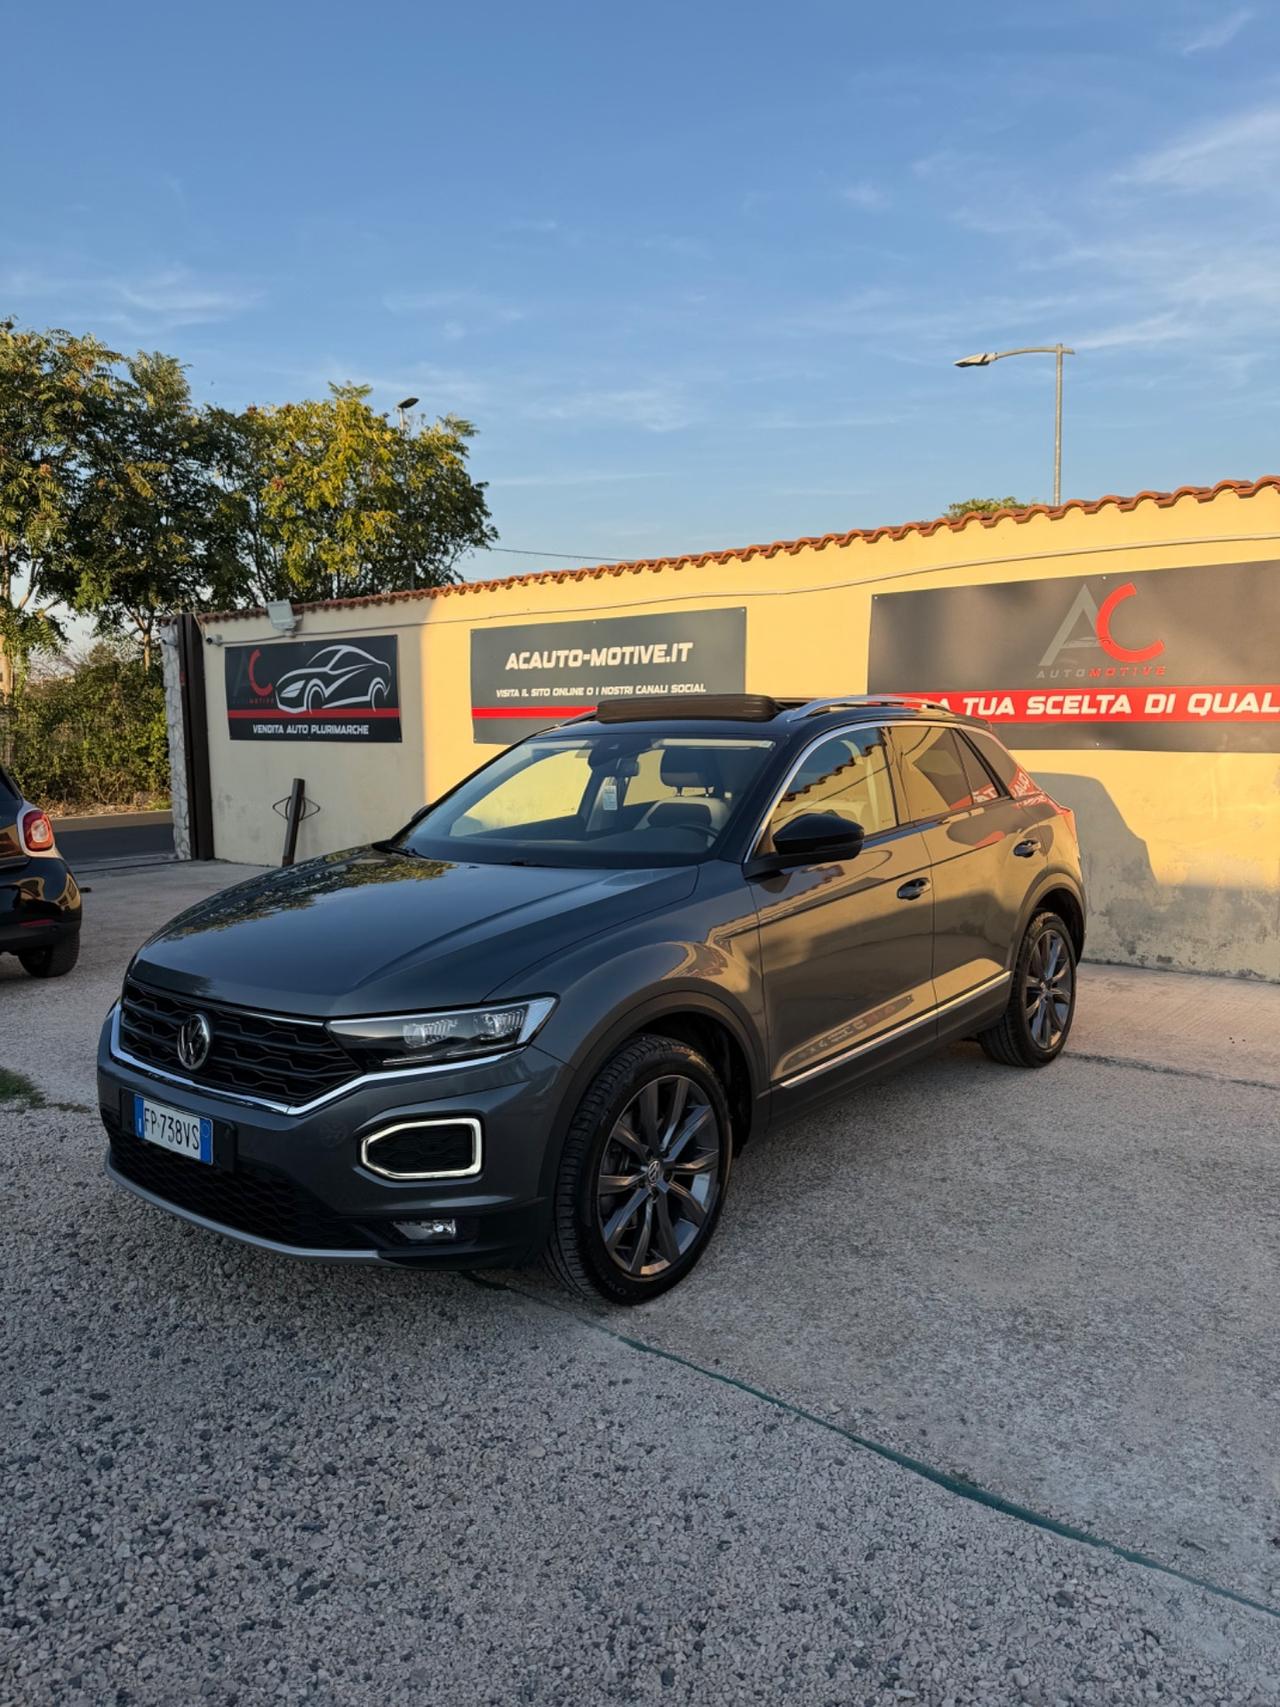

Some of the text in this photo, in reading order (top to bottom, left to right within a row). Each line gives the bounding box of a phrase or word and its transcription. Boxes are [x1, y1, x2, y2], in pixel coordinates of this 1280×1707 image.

[1038, 582, 1165, 664] AC
[505, 642, 693, 670] ACAUTO-MOTIVE.IT
[1036, 666, 1166, 679] AUTOMOTIVE
[496, 683, 707, 698] VISITA IL SITO ONLINE O I NOSTRI CANALI SOCIAL
[963, 696, 1015, 716] TUA
[1026, 694, 1132, 716] SCELTA
[1144, 693, 1176, 714] DI
[1187, 692, 1280, 717] QUAL
[253, 723, 370, 735] VENDITA AUTO PLURIMARCHE
